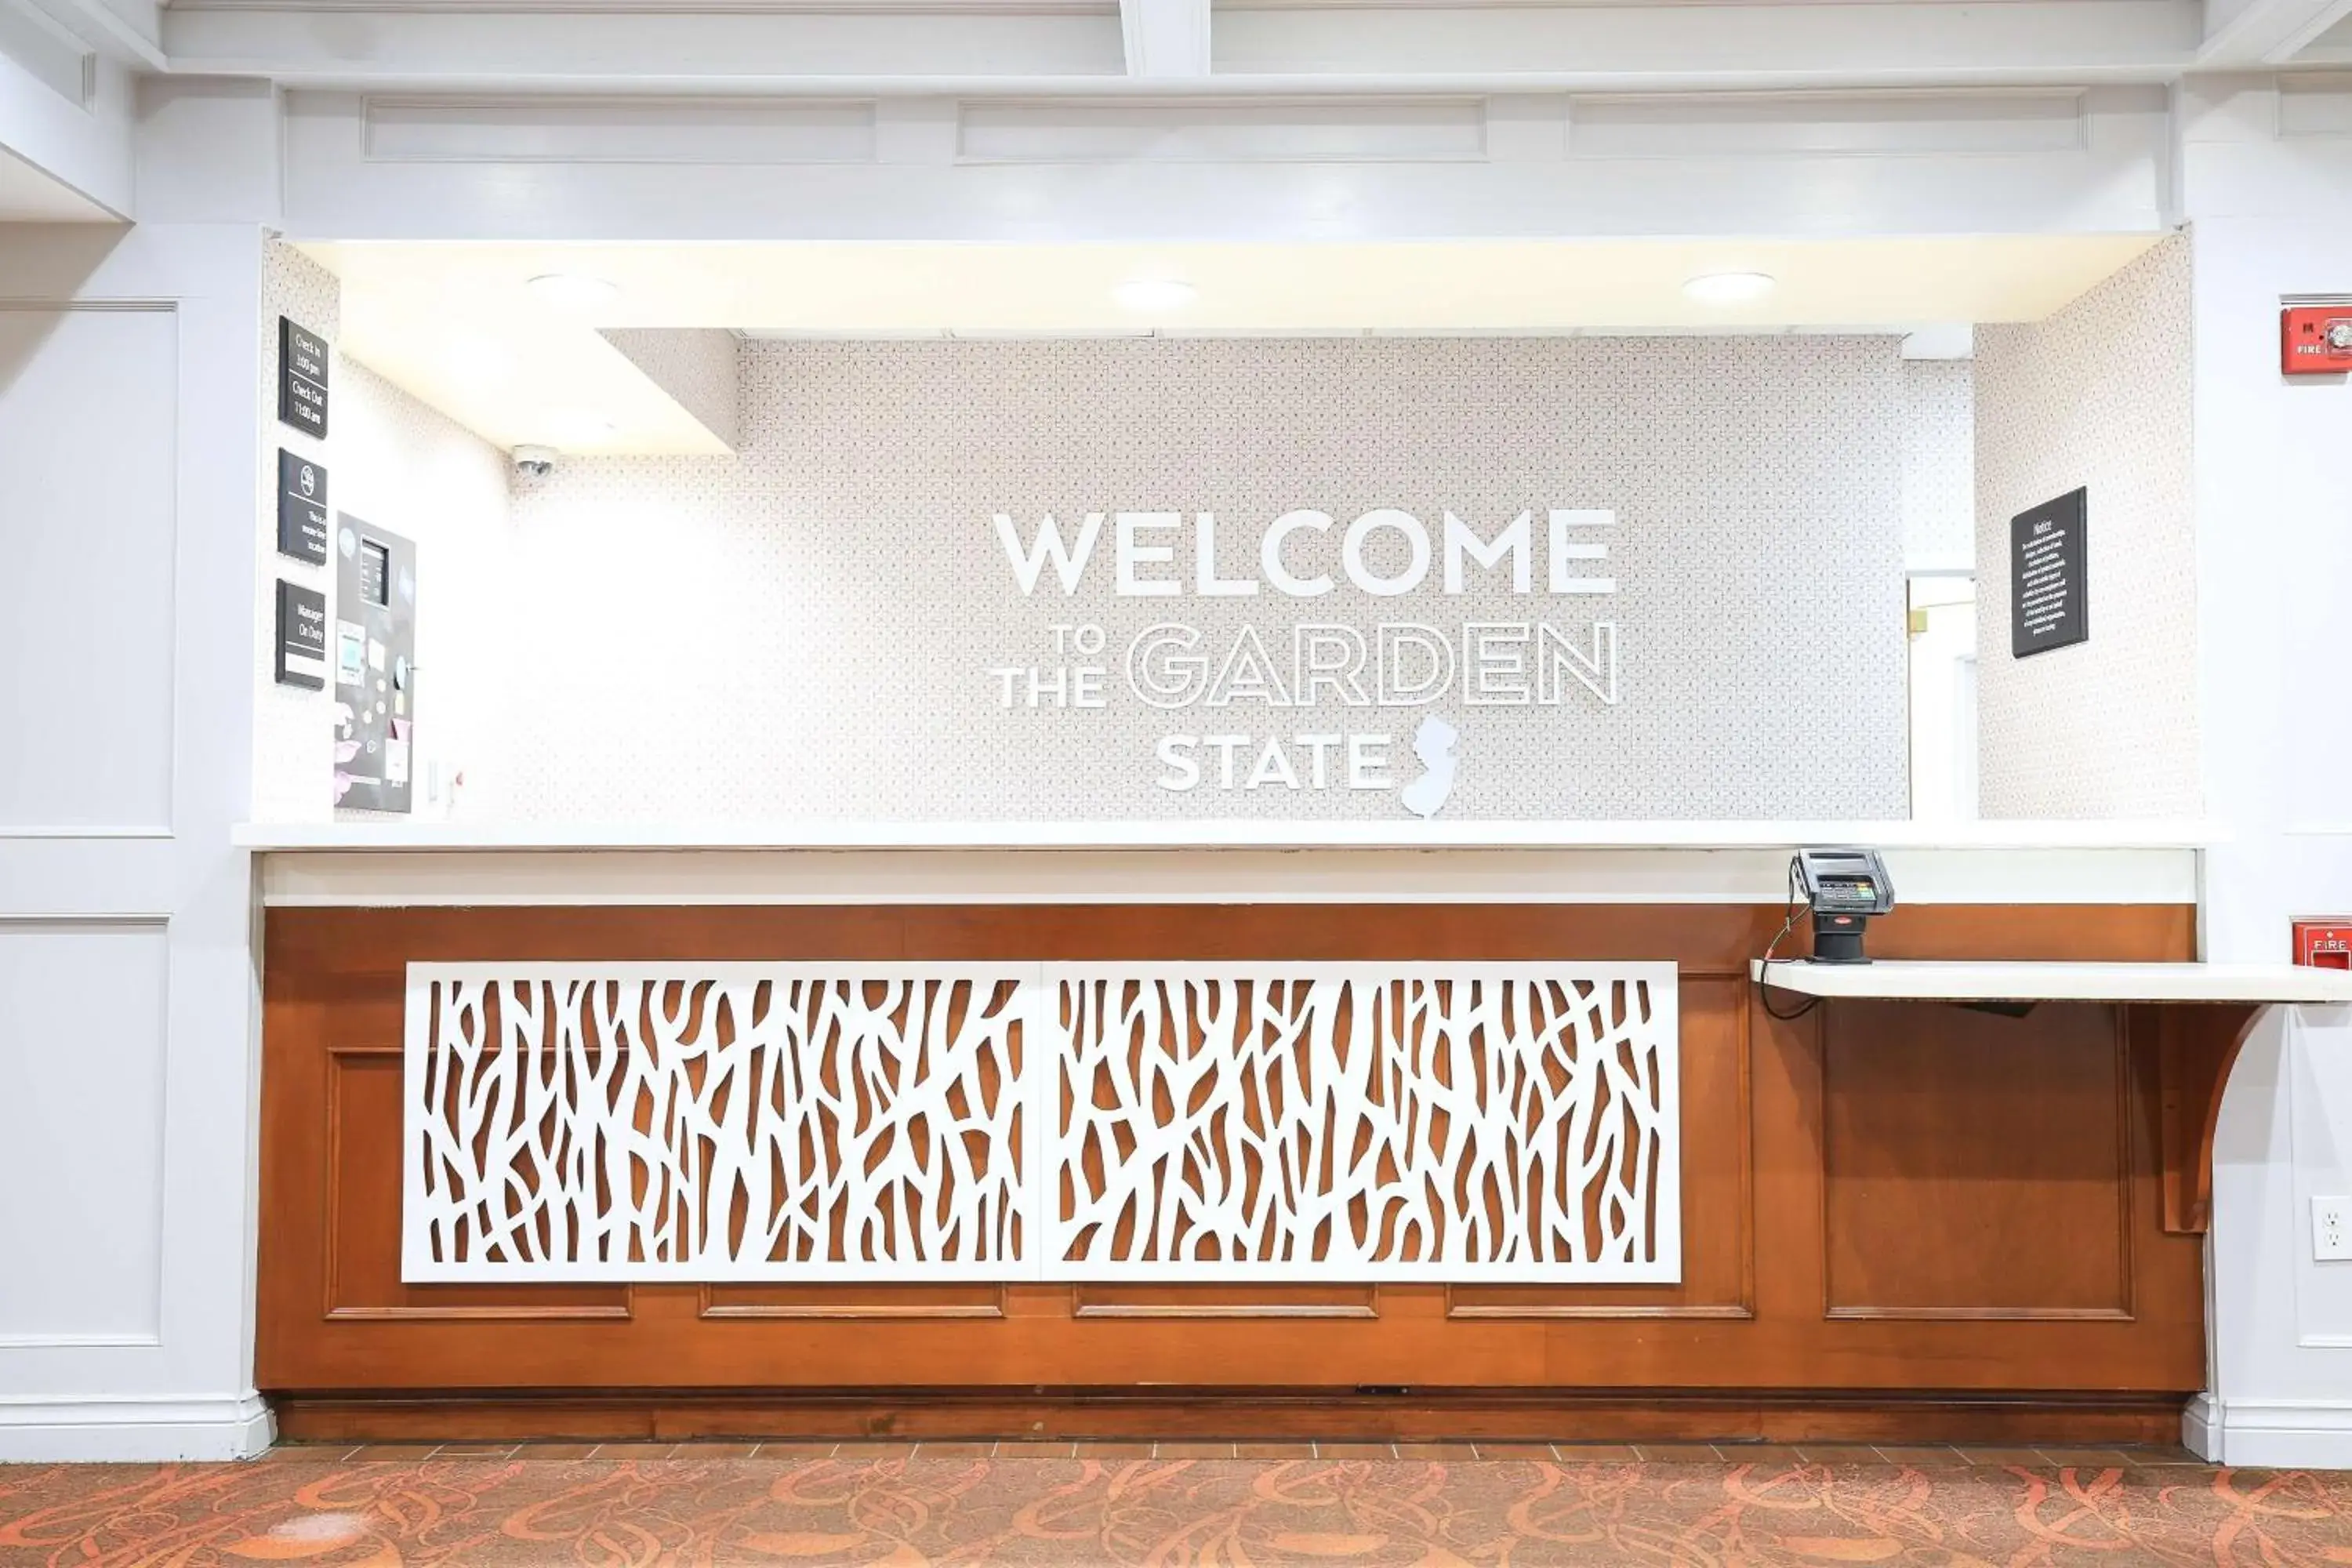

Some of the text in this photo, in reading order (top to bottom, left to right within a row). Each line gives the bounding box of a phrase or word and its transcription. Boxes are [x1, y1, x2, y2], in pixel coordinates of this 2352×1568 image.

[2298, 345, 2321, 354] FIRE
[992, 509, 1617, 597] WELCOME
[1048, 626, 1106, 657] TO
[990, 622, 1617, 710] THE GARDEN
[1155, 733, 1393, 791] STATE
[2314, 940, 2347, 949] FIRE
